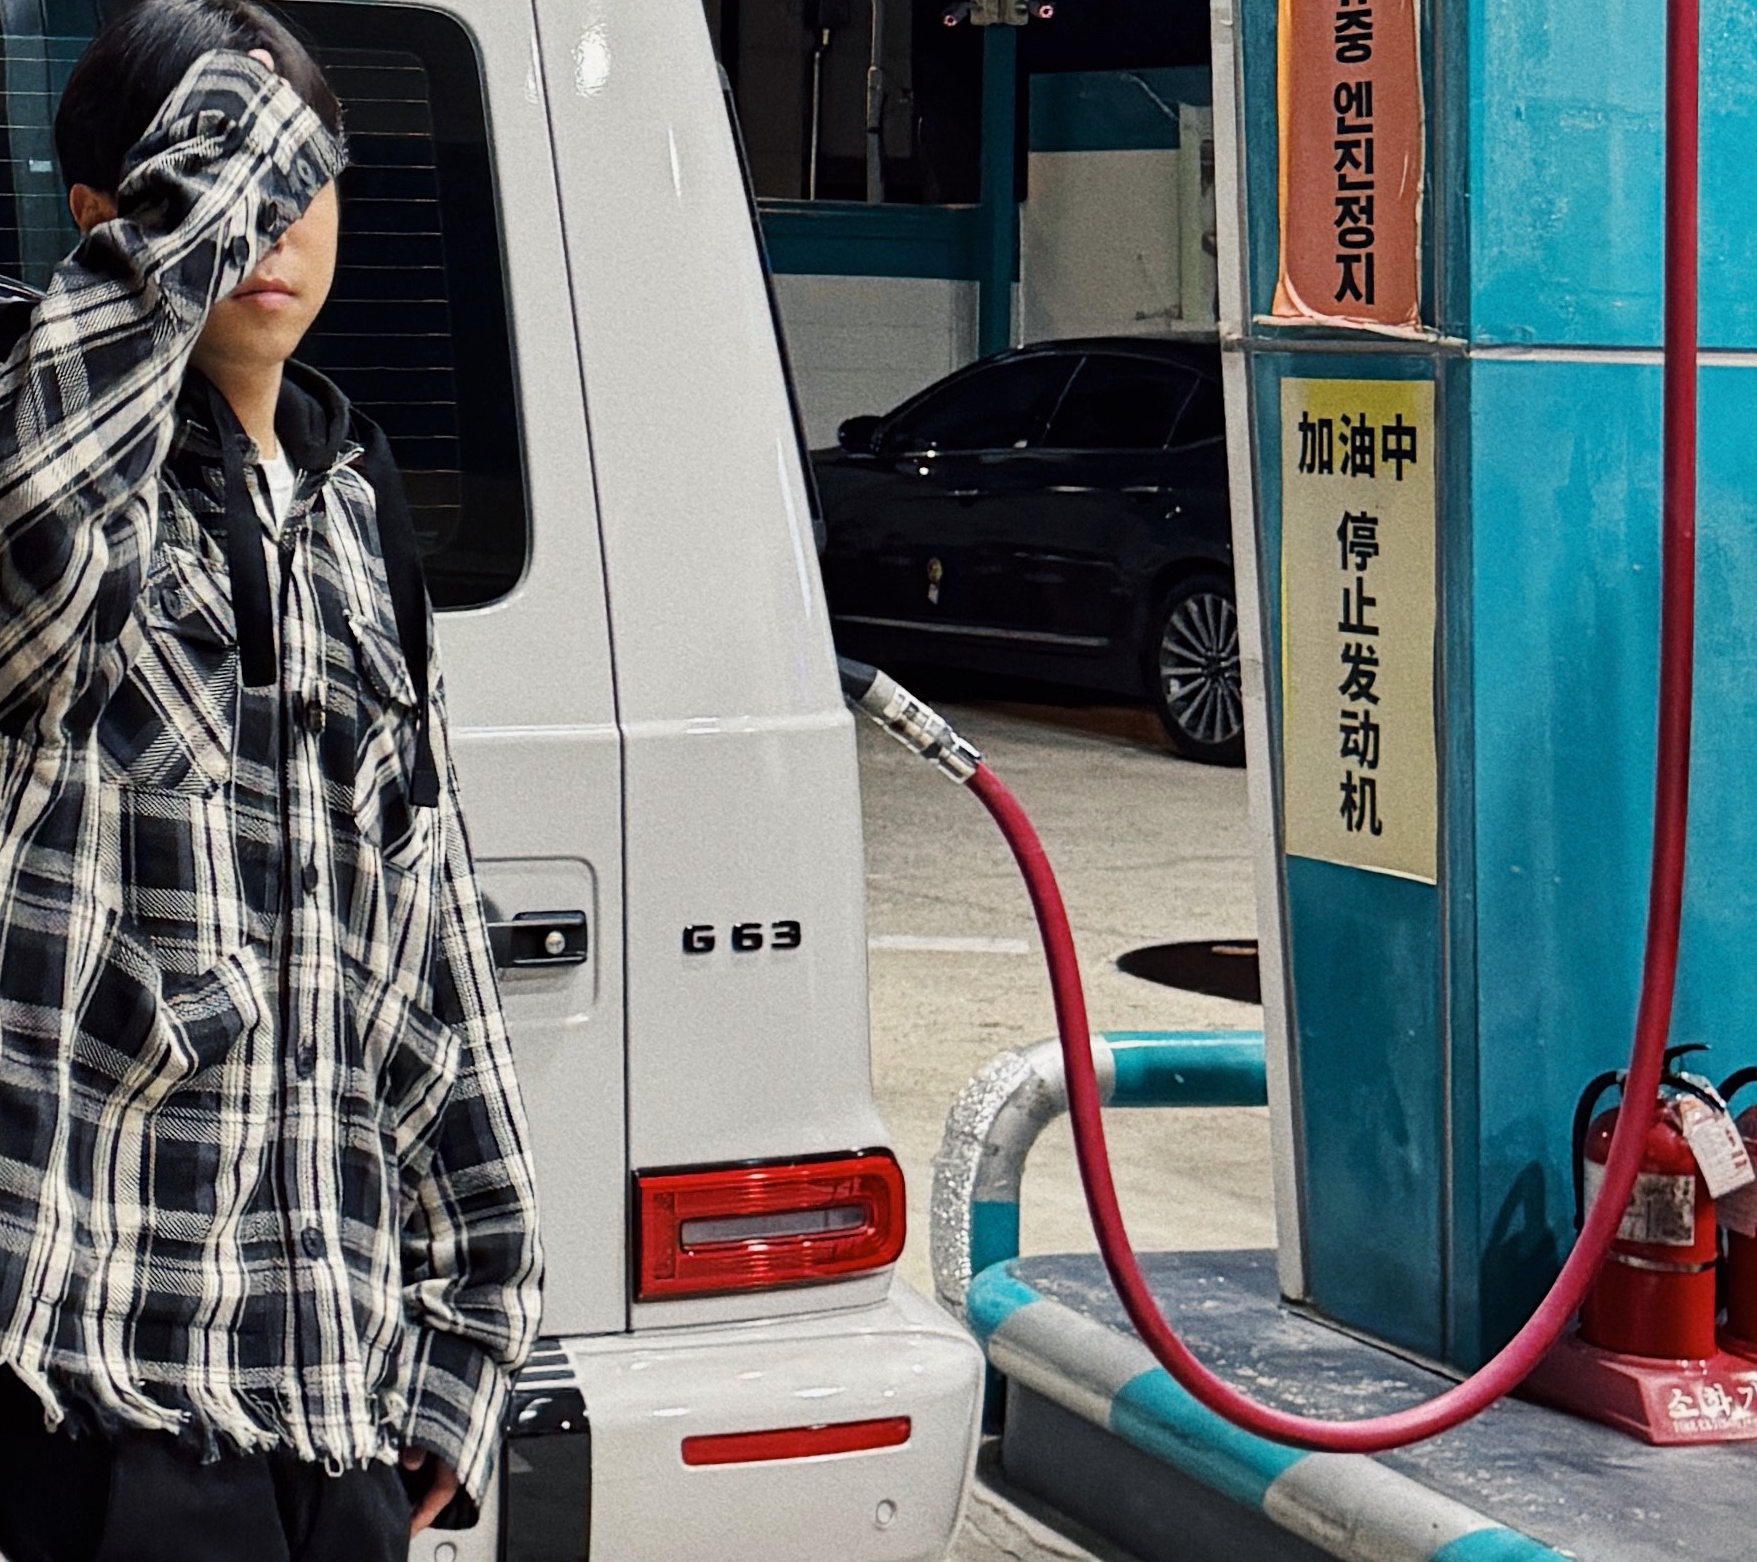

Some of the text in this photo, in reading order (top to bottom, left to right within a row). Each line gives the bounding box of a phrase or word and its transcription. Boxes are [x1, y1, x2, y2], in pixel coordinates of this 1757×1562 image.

[1333, 80, 1376, 305] 엔진정지
[1297, 411, 1418, 481] 加油中
[1337, 510, 1383, 837] 停止发动机
